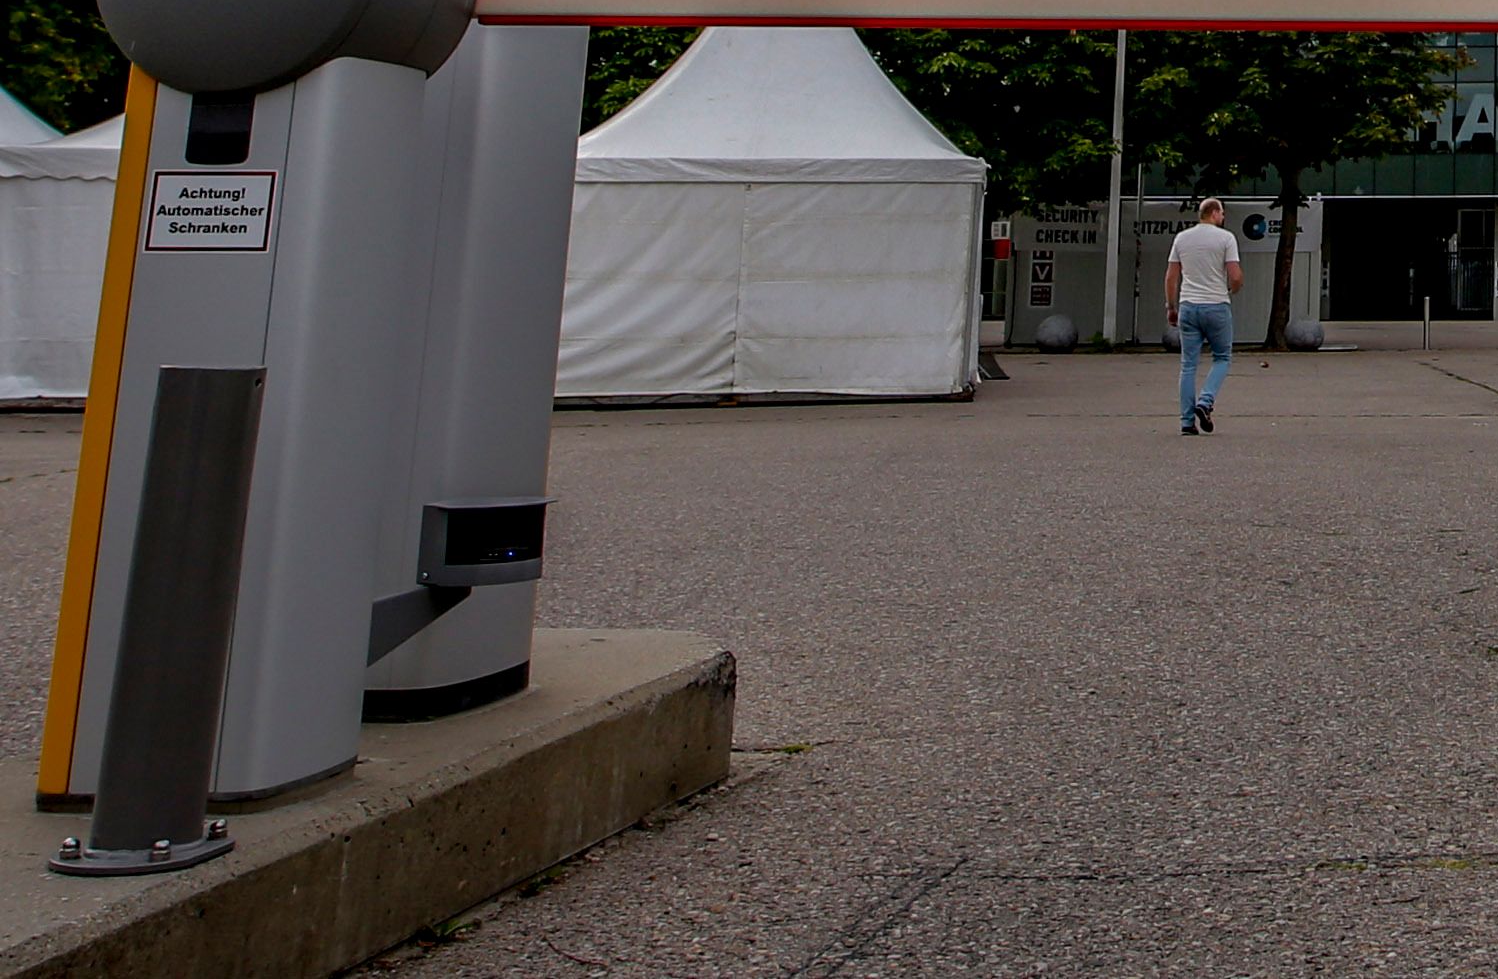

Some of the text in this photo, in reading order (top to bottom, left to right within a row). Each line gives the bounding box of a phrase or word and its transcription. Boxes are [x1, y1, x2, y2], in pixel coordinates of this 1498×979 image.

[179, 187, 246, 202] Achtung!
[156, 204, 265, 216] Automatischer
[1036, 209, 1099, 223] SECURITY
[168, 222, 247, 233] Schranken
[1036, 229, 1097, 244] CHECK IN
